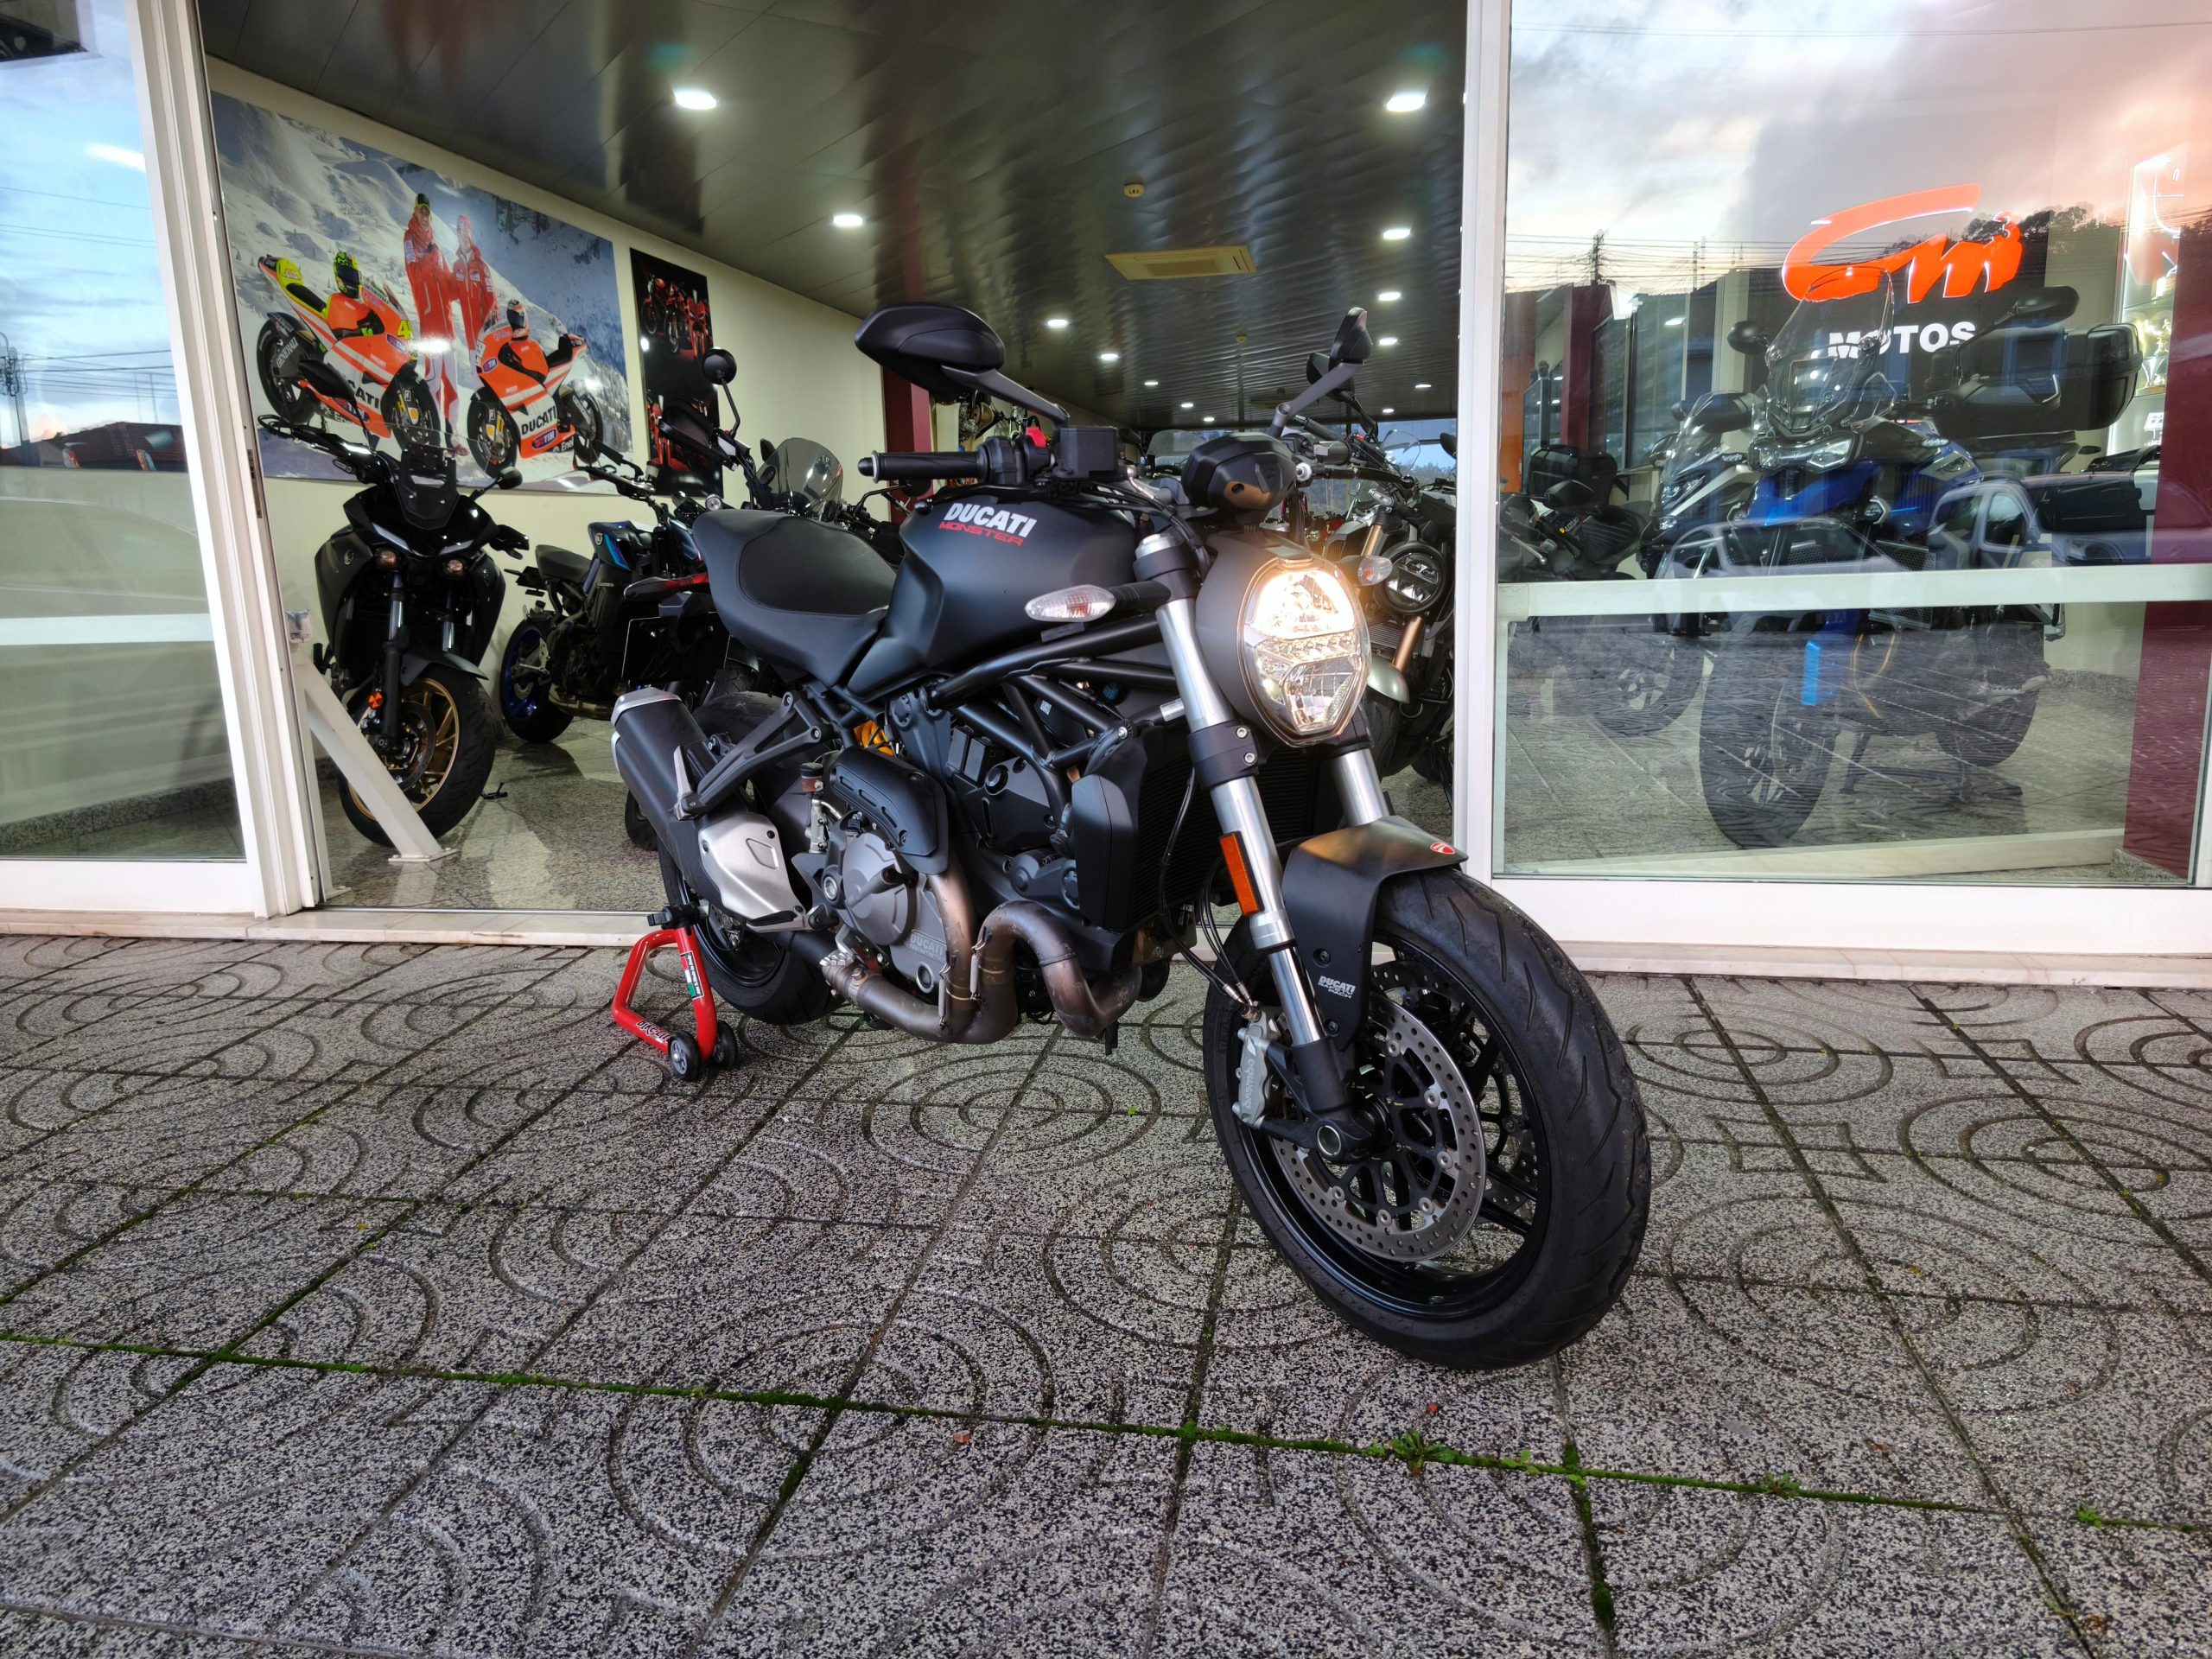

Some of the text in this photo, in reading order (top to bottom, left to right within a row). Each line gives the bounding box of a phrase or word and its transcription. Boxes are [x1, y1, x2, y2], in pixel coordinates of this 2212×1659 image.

[276, 336, 299, 368] GENERALI
[521, 405, 556, 435] DUCATI
[543, 431, 556, 446] TIM
[944, 502, 1038, 538] DUCATI
[938, 521, 1024, 547] MONSTER
[910, 934, 944, 956] DUCATI
[1319, 975, 1357, 994] DUCATI
